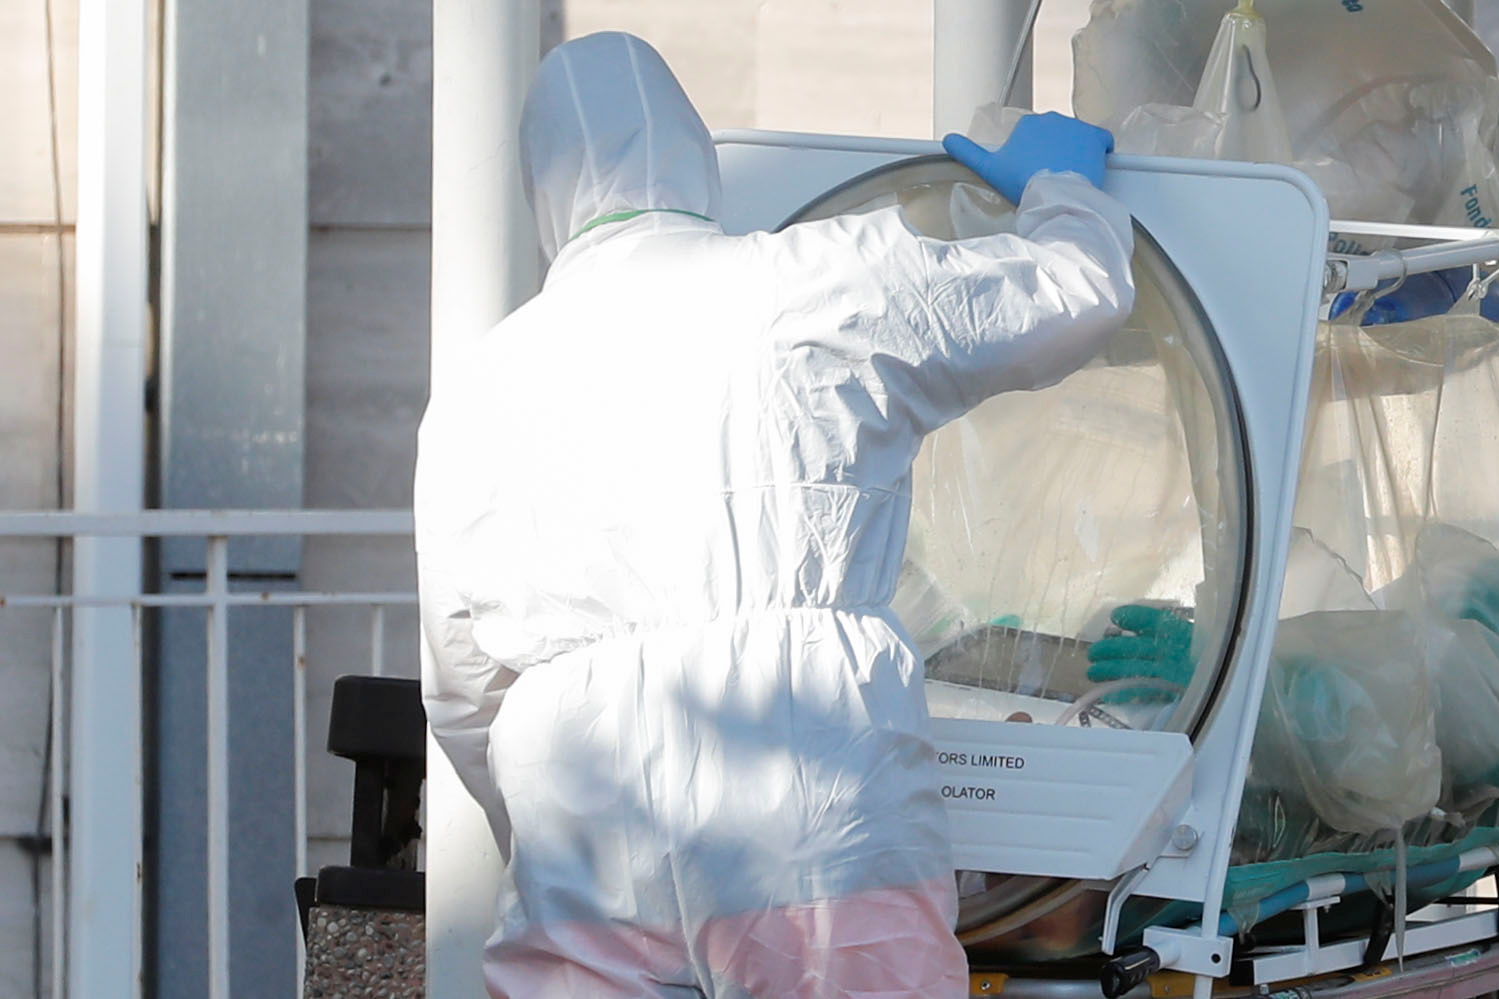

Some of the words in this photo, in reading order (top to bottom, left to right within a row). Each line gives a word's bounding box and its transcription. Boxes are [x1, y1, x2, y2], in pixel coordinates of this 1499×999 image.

[936, 751, 968, 766] ORS
[970, 754, 1025, 769] LIMITED
[941, 785, 996, 800] OLATOR
